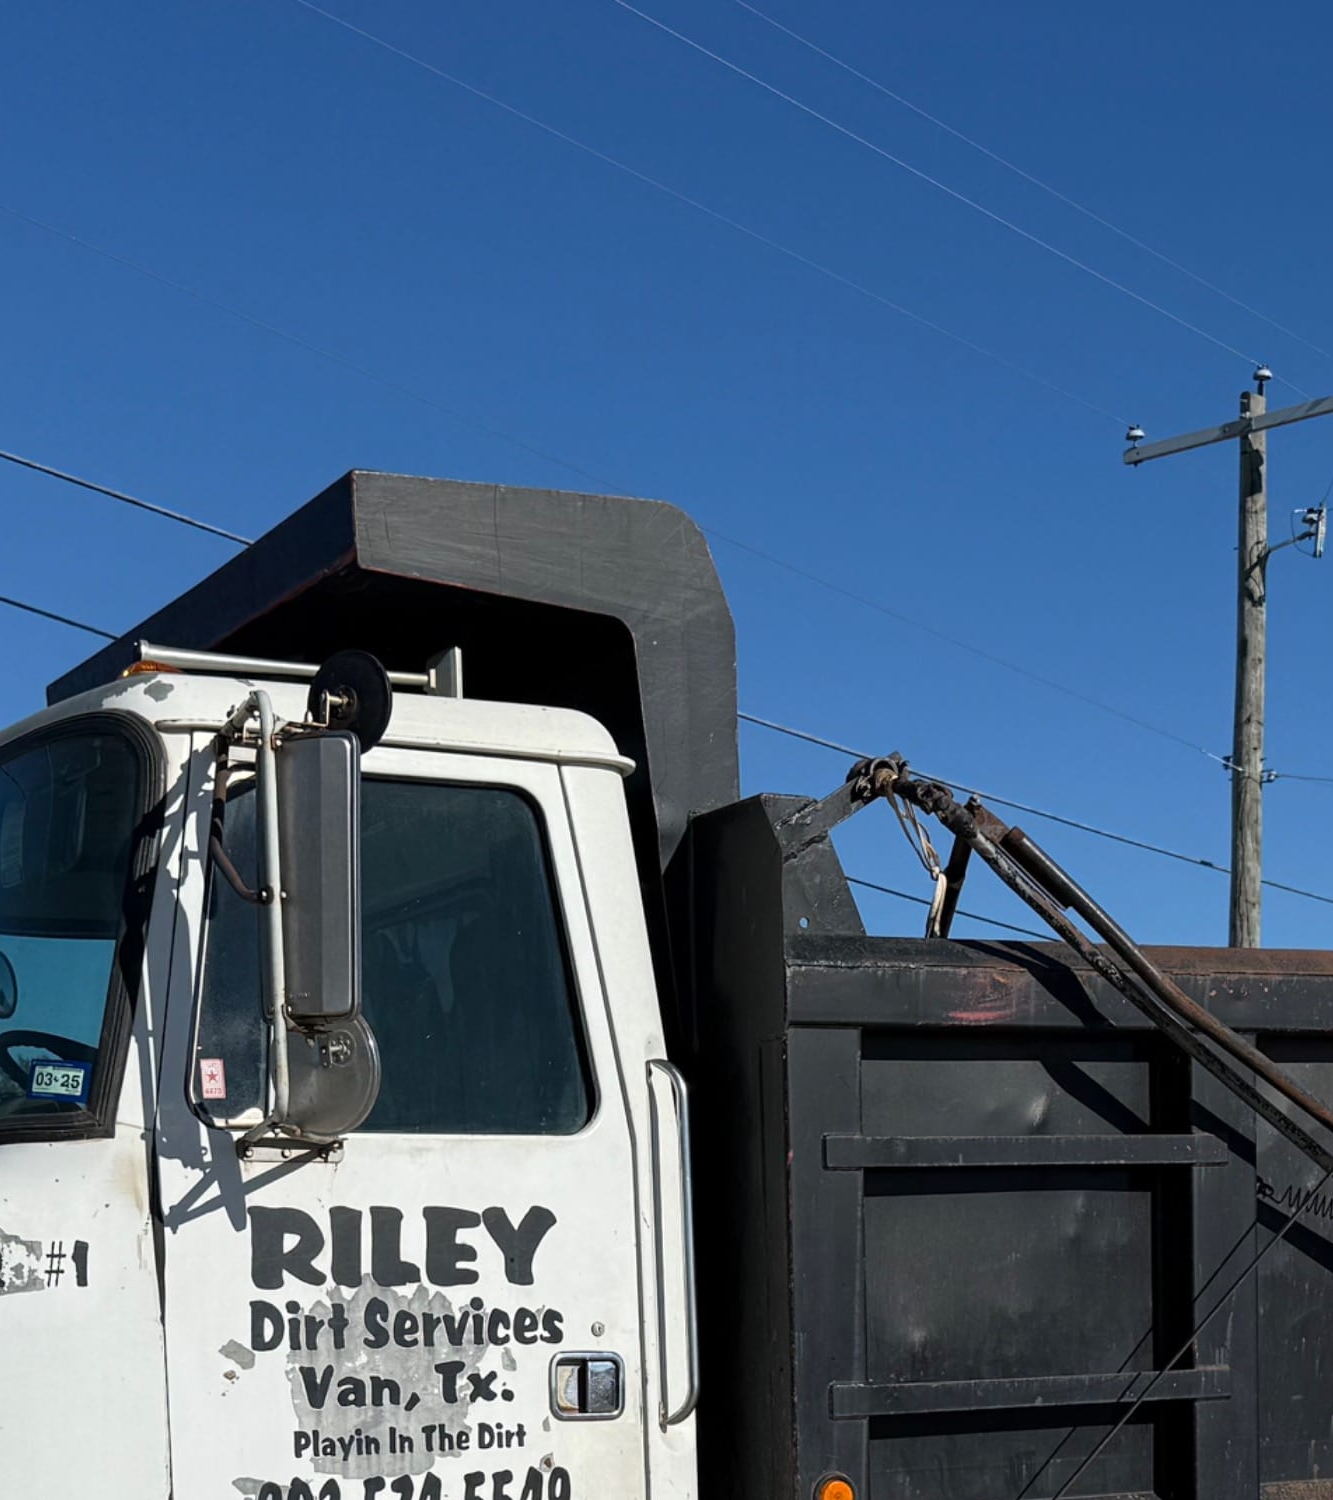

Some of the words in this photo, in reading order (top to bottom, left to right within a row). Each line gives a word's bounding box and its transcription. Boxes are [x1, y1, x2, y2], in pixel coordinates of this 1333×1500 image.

[247, 1205, 557, 1290] RILEY
[249, 1300, 349, 1351] Dirt
[363, 1297, 564, 1348] Services
[299, 1364, 421, 1411] Van,
[434, 1361, 515, 1404] Tx.
[293, 1428, 381, 1461] Playin
[389, 1426, 414, 1454] In
[421, 1423, 471, 1453] The
[477, 1422, 527, 1450] Dirt
